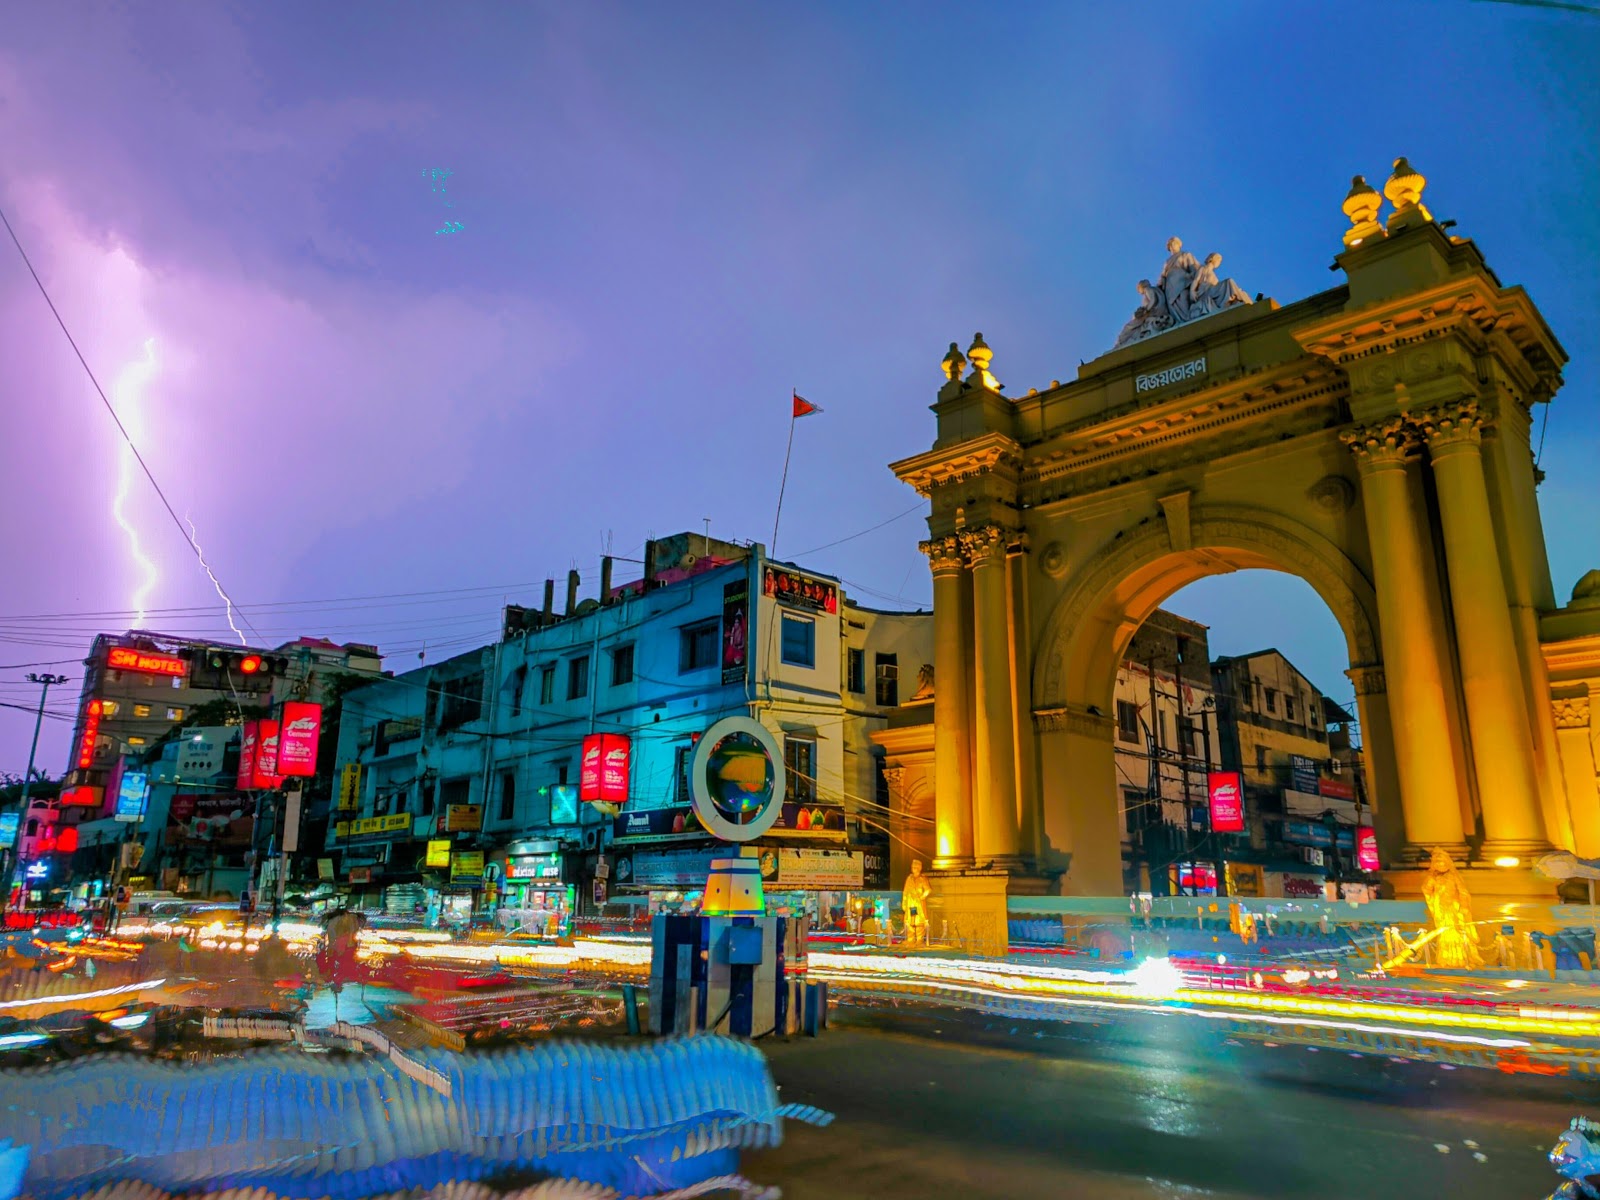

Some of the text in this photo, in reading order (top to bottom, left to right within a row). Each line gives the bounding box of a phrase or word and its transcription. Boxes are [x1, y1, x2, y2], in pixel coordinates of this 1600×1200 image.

[1136, 357, 1206, 393] বিজয়তোরণ
[138, 657, 183, 673] HOTEL
[285, 717, 317, 730] JSW
